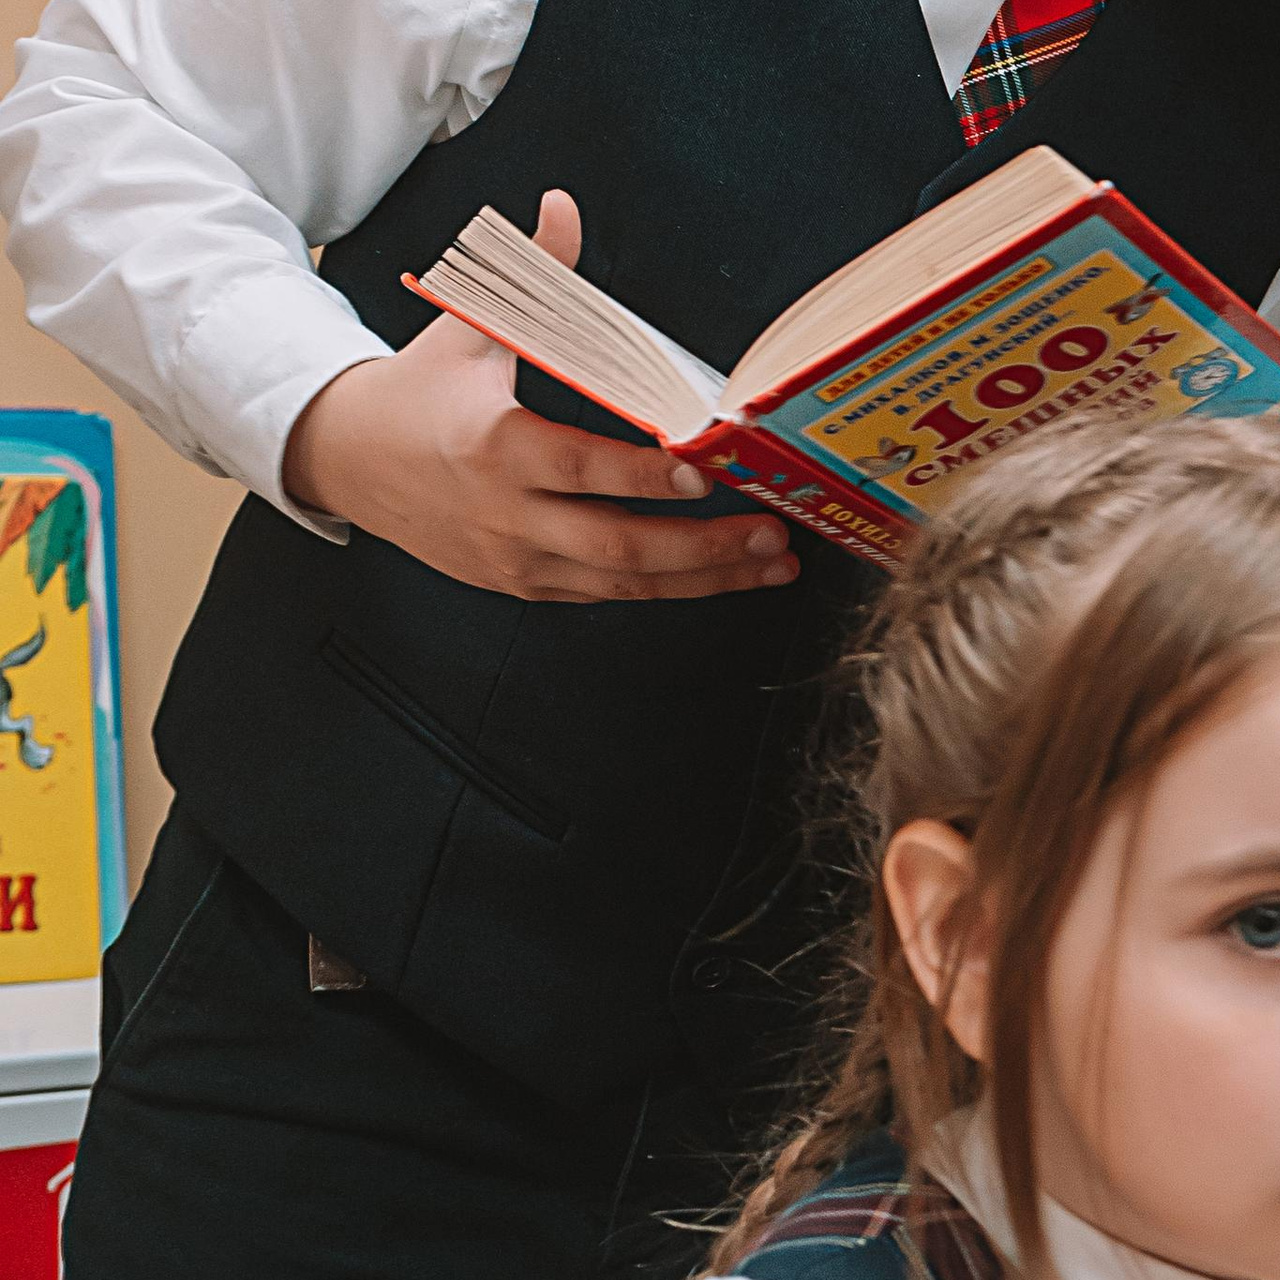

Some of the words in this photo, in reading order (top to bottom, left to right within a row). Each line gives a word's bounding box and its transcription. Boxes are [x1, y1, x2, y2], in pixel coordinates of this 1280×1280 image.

[996, 265, 1111, 333] ЗОЩЕНКО,
[904, 326, 1181, 488] СМЕШНЫХ
[909, 324, 1112, 453] 100
[736, 483, 843, 534] ИСТОРИЙ
[818, 502, 900, 550] СТИХОВ
